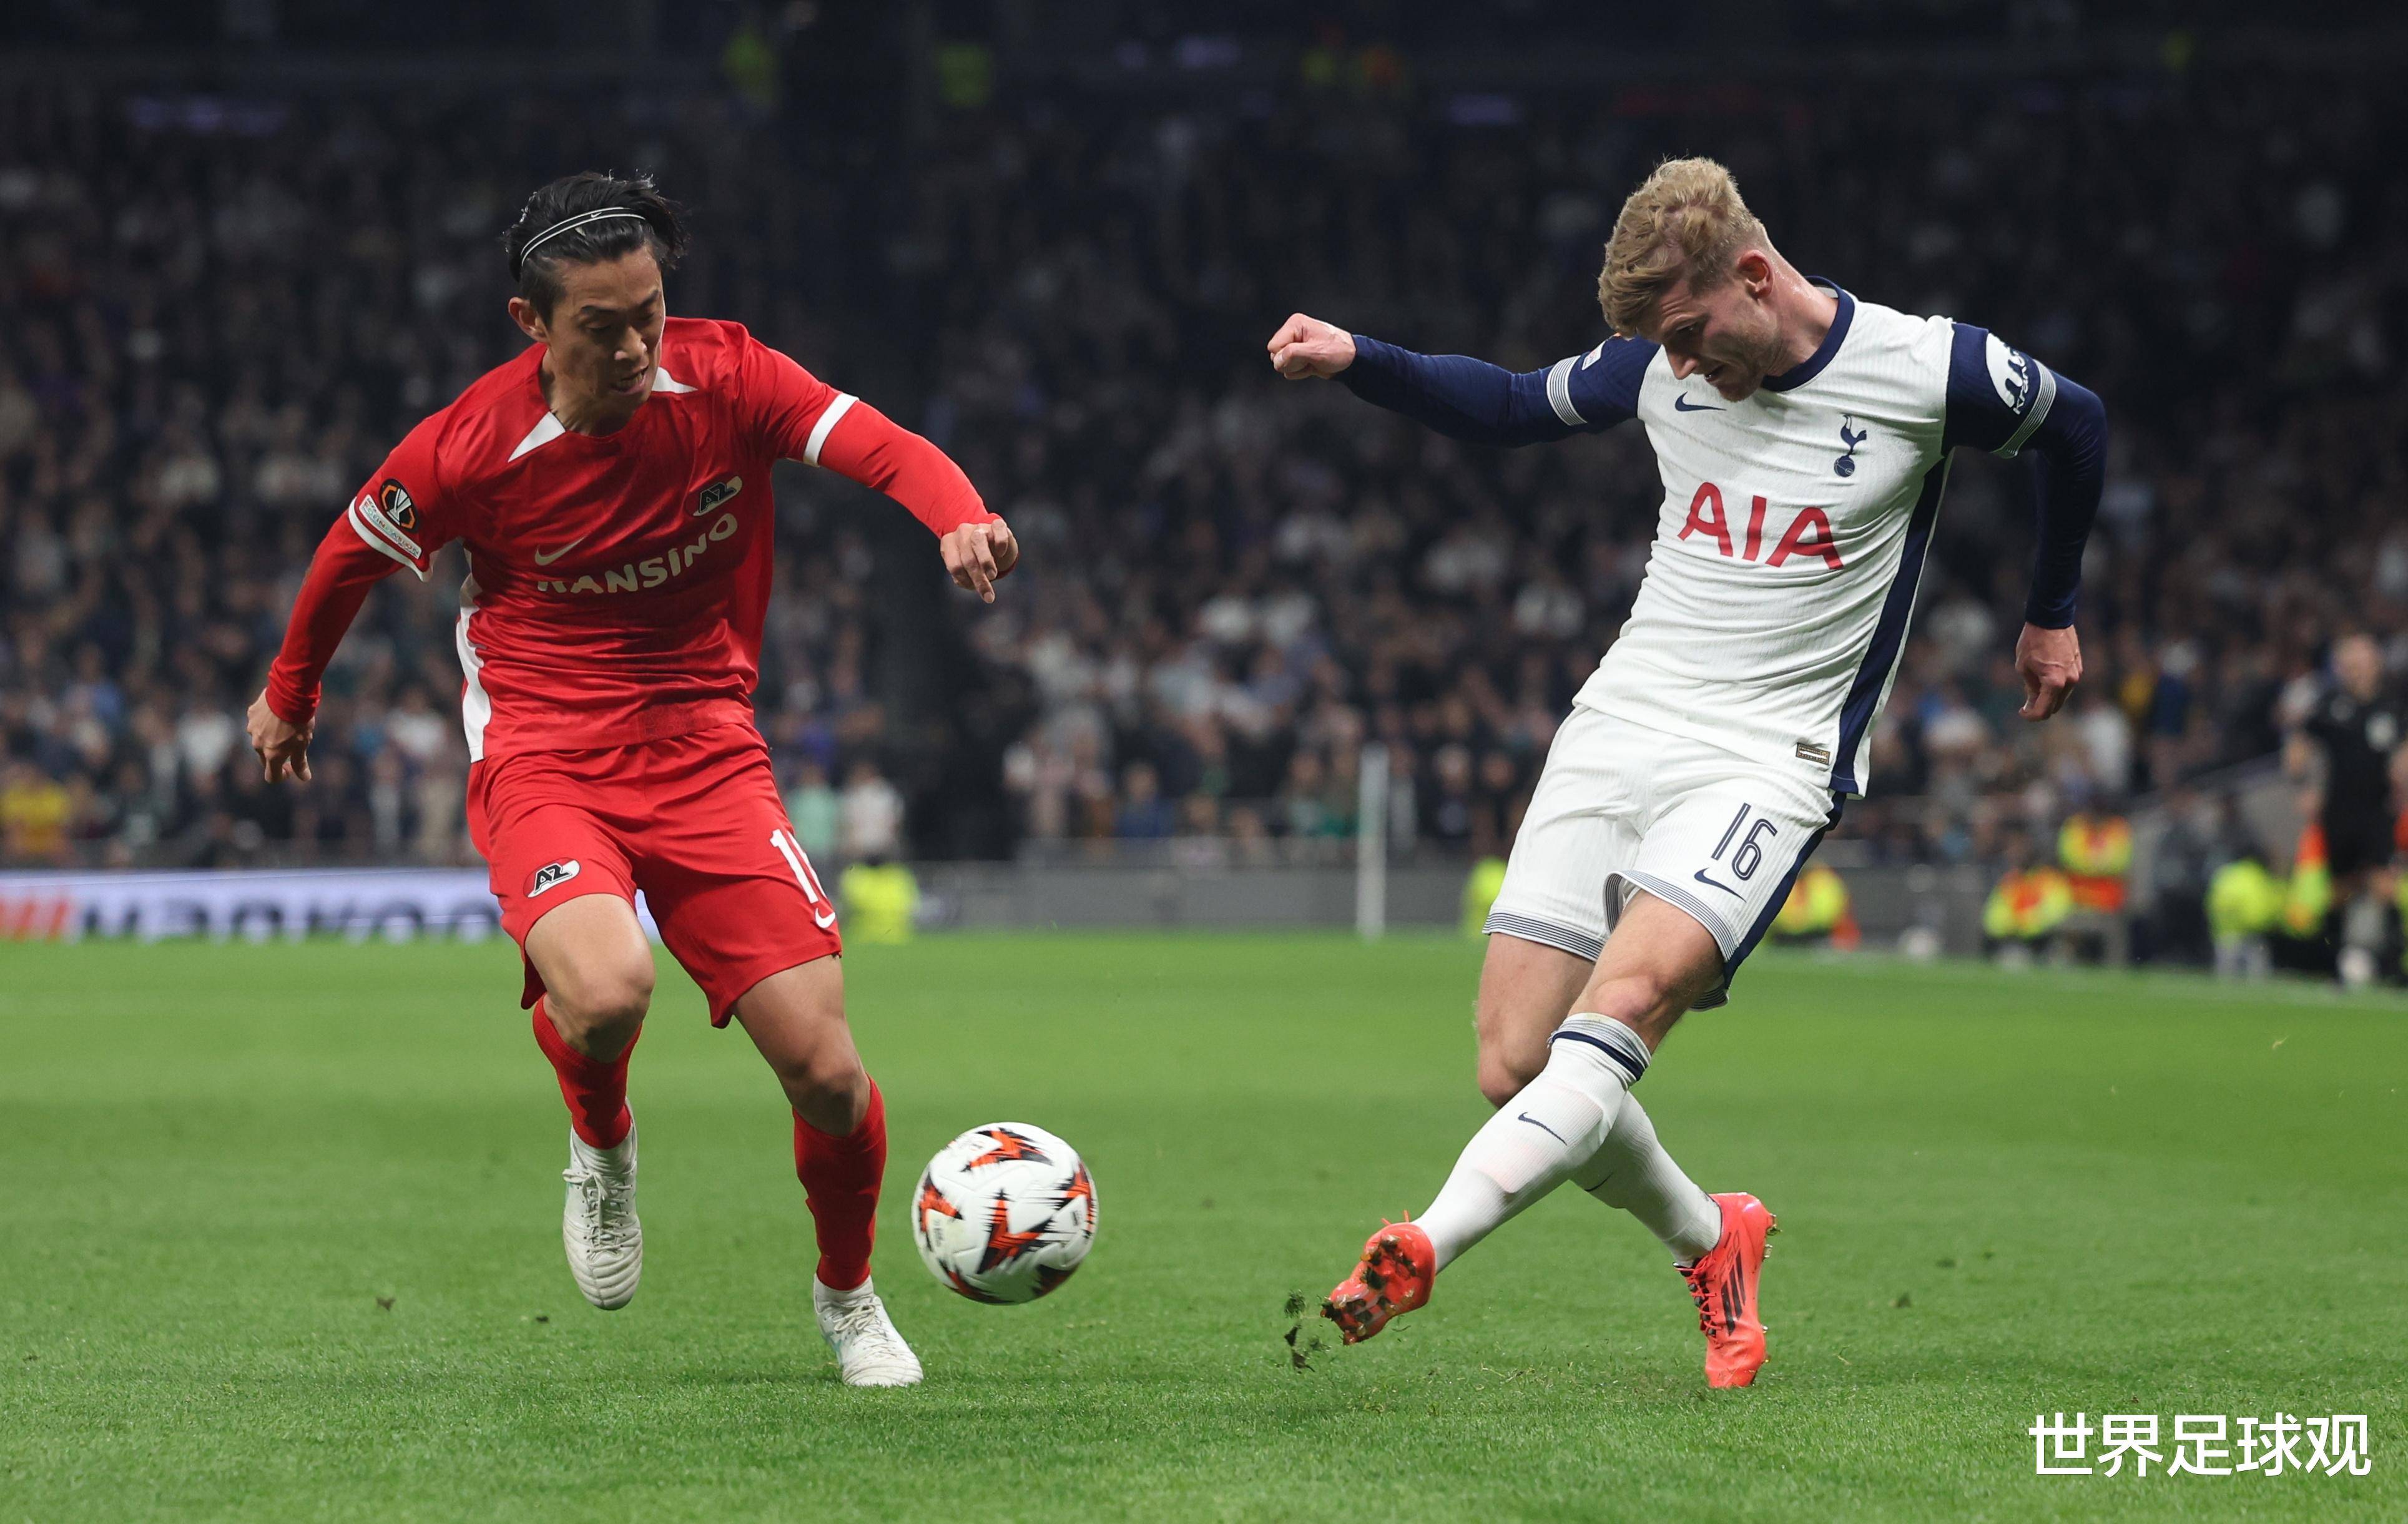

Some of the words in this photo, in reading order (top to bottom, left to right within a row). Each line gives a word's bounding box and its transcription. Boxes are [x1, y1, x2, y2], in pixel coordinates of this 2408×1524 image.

[699, 481, 737, 513] AZ
[1678, 482, 1844, 569] AIA
[1711, 802, 1777, 881] 16
[534, 863, 572, 893] AZ
